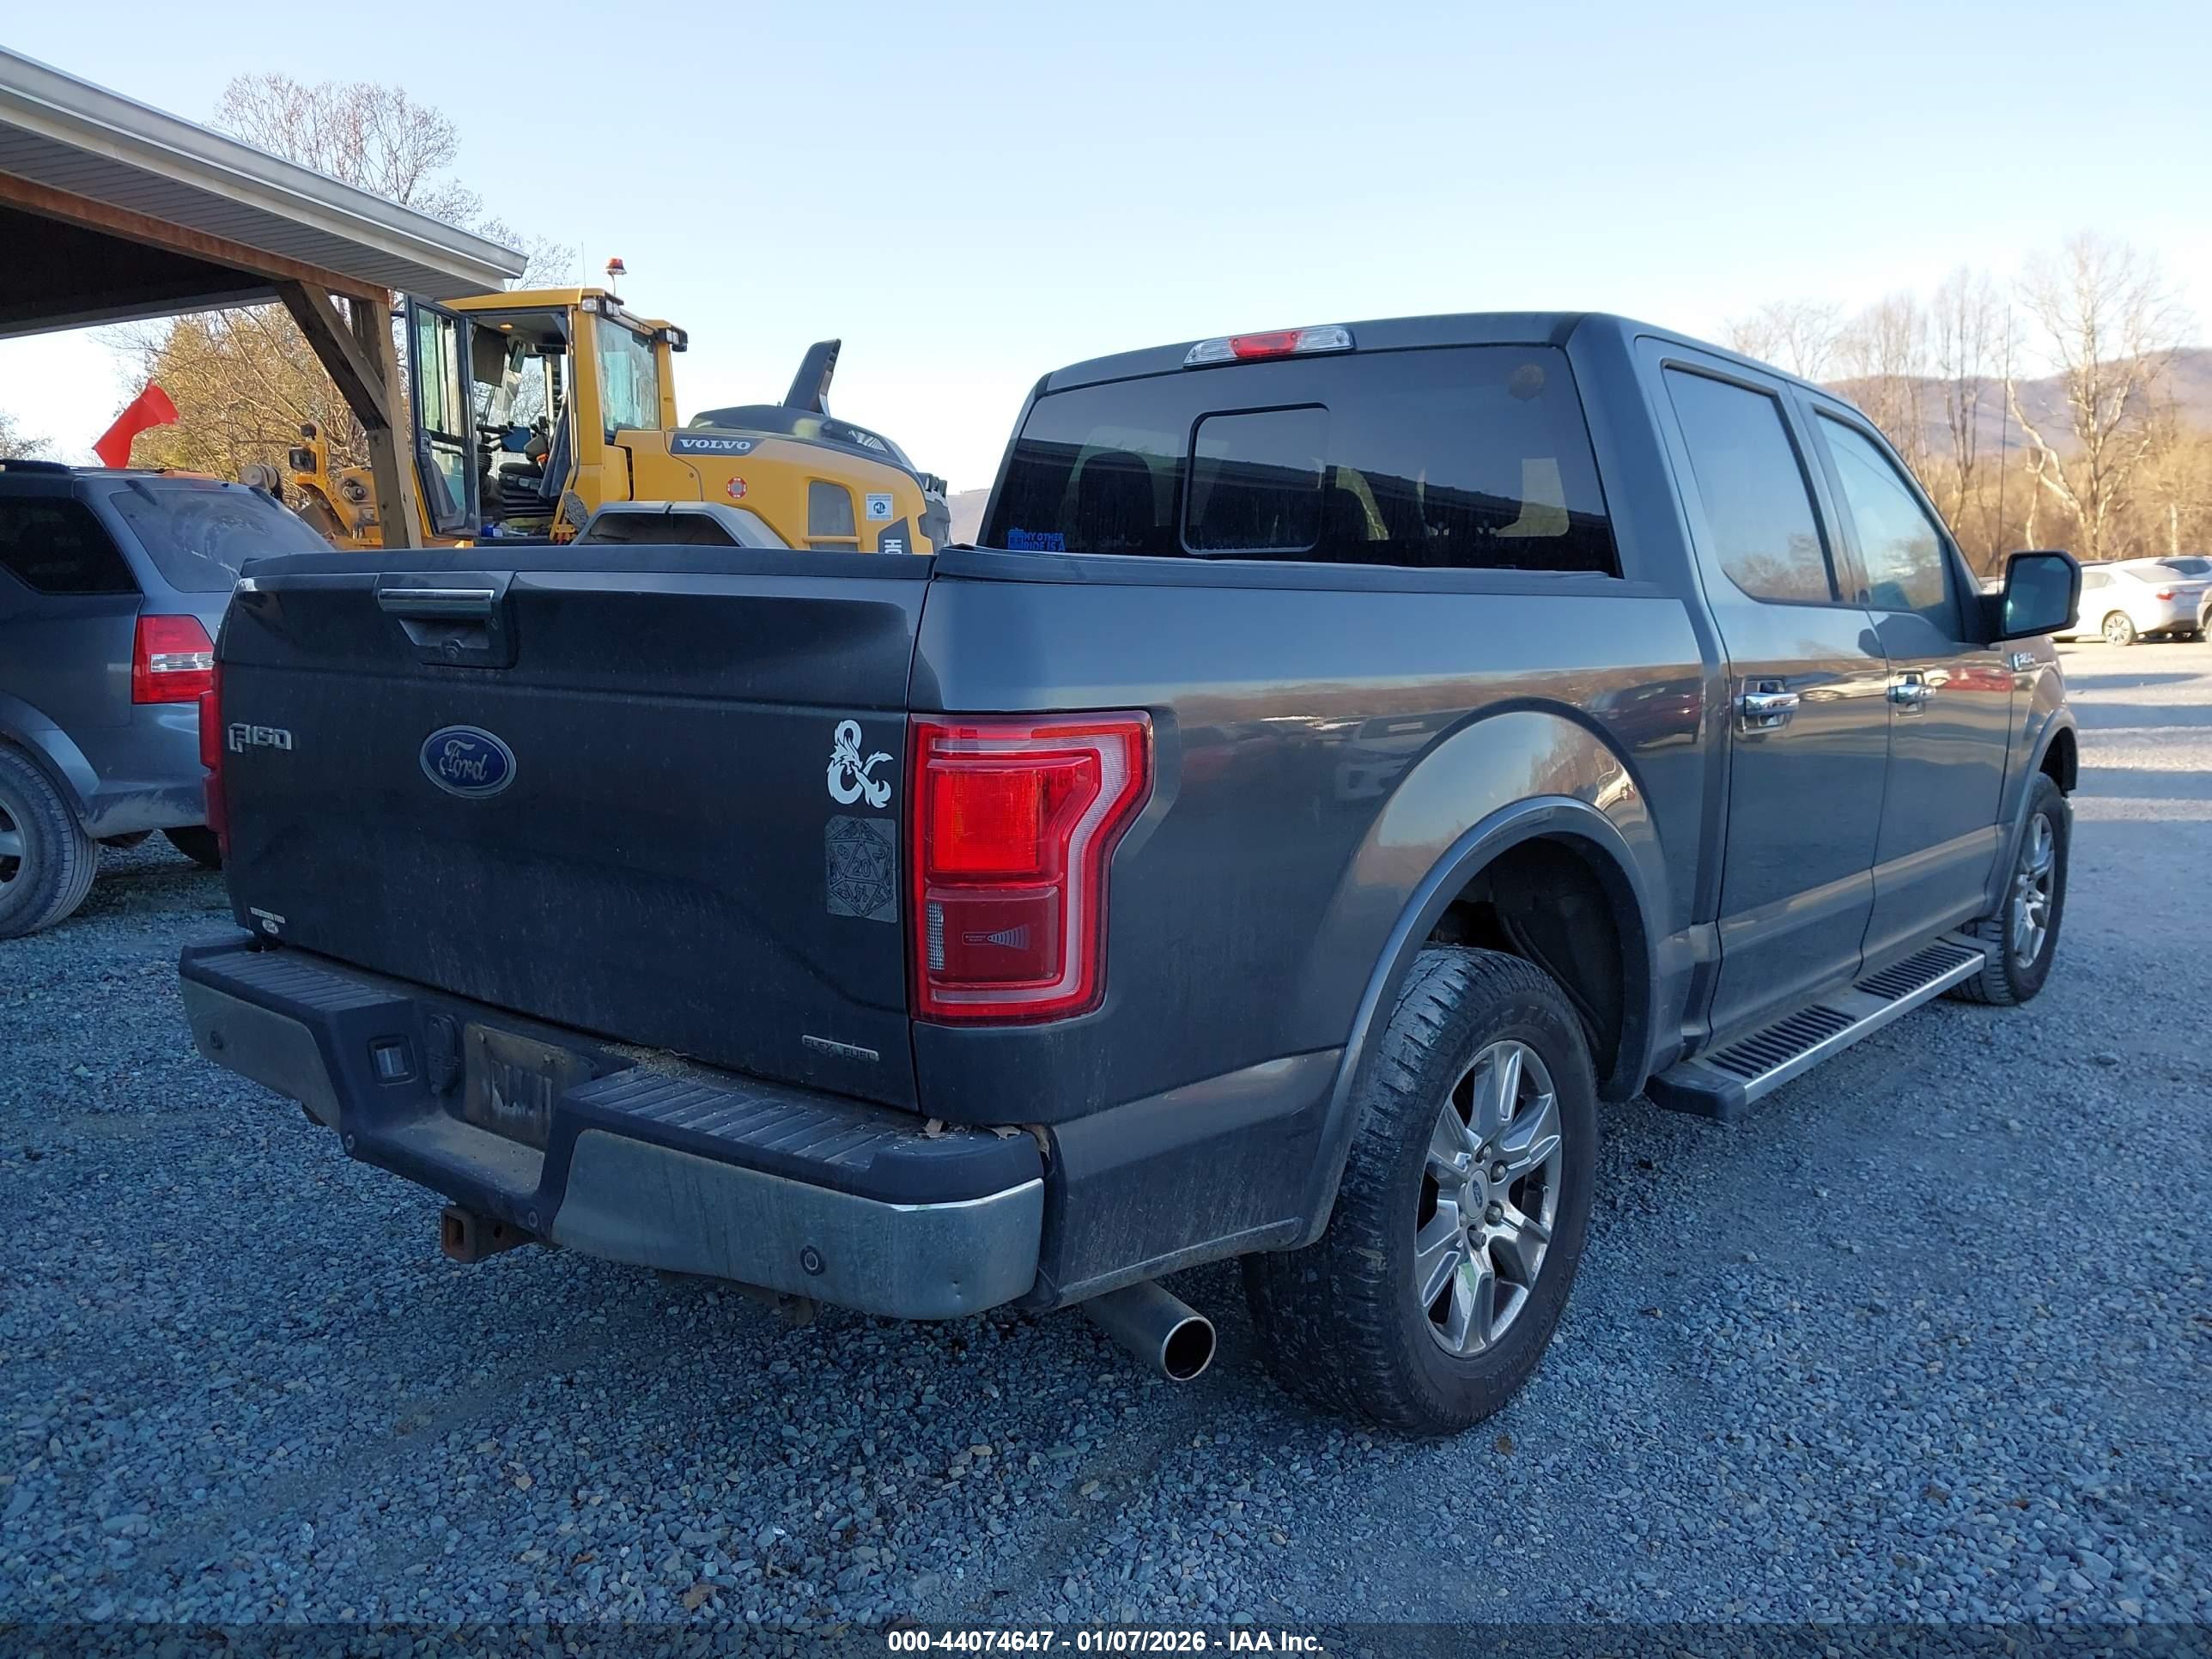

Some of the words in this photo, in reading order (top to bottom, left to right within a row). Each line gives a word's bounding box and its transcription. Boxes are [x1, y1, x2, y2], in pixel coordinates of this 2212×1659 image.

[680, 439, 751, 450] VOLVO
[1024, 541, 1045, 550] RIDE
[1047, 542, 1056, 550] IS
[1057, 542, 1066, 551] A
[439, 738, 488, 781] Ford
[853, 858, 871, 877] 20
